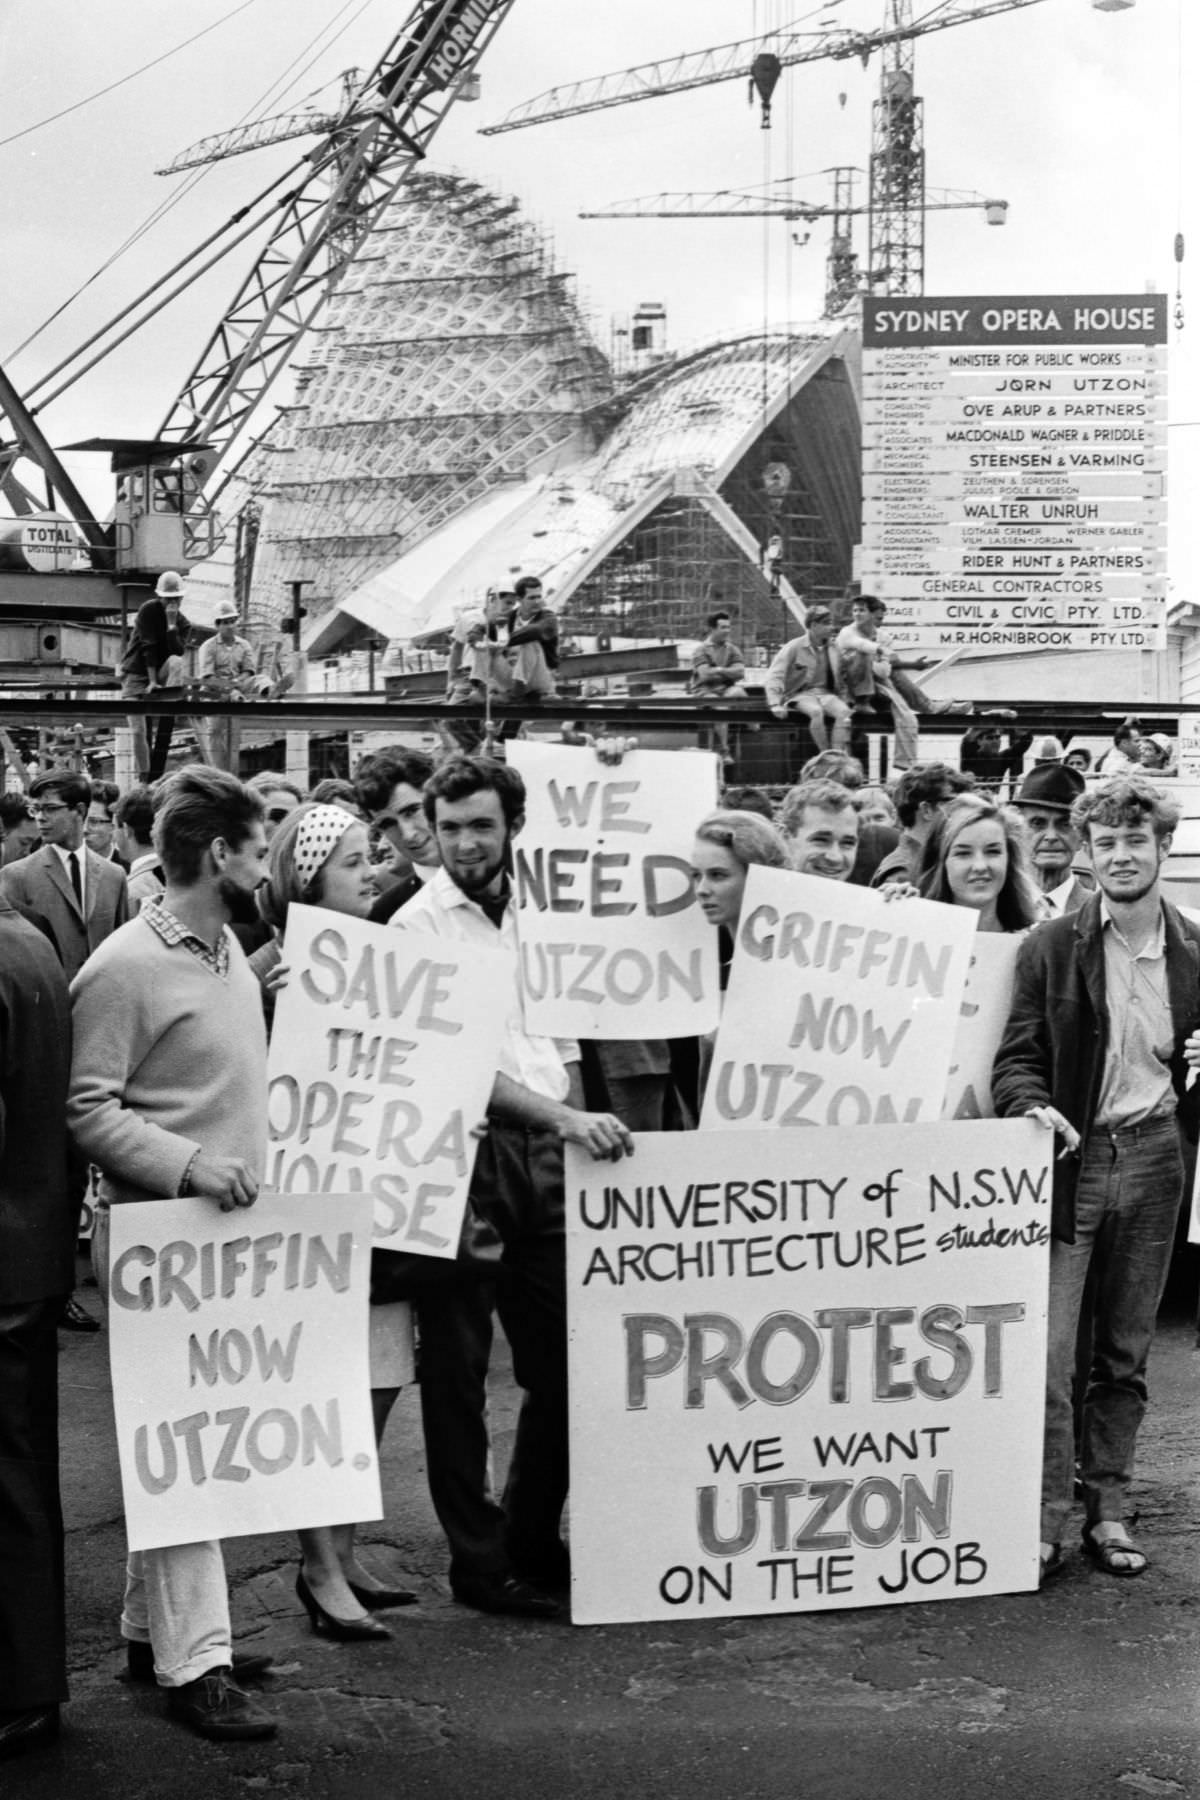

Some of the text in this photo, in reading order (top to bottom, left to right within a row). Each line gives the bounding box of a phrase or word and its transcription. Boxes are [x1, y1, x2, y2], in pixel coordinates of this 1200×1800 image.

[875, 307, 1155, 333] SYDNEY OPERA HOUSE
[884, 381, 945, 391] ARCHITECT
[949, 354, 1001, 367] MINISTER
[1007, 354, 1028, 367] FOR
[1035, 353, 1073, 367] PUBLIC
[1080, 353, 1121, 366] WORKS
[1074, 377, 1146, 392] UTZON
[946, 428, 1144, 442] MACDONALD WAGNER & PRIDDLE
[963, 403, 1146, 417] OVE ARUP & PARTNERS
[969, 454, 1145, 467] STEENSEN & VARMING
[27, 528, 73, 543] TOTAL
[963, 504, 1098, 519] WALTER UNRUH
[922, 579, 1103, 593] GENERAL CONTRACTORS
[962, 555, 1144, 568] RIDER HUNT & PARTNERS
[946, 606, 984, 619] CIVIL
[990, 607, 999, 619] &
[1012, 605, 1056, 619] CIVIC
[547, 779, 652, 834] WE
[516, 848, 697, 918] NEED
[521, 942, 705, 1006] UTZON
[740, 904, 953, 998] GRIFFIN
[301, 928, 463, 1036] SAVE
[326, 1027, 419, 1088] THE
[787, 992, 913, 1069] NOW
[267, 1073, 469, 1178] OPERA
[580, 1176, 848, 1230] UNIVERSITY
[862, 1168, 903, 1218] of
[111, 1232, 354, 1313] GRIFFIN
[582, 1218, 1050, 1287] ARCHITECTURE students
[188, 1320, 304, 1389] NOW
[621, 1302, 1026, 1411] PROTEST
[134, 1397, 371, 1496] UTZON.
[707, 1426, 951, 1474] WE WANT
[695, 1468, 953, 1559] UTZON
[659, 1541, 988, 1605] ON THE JOB
